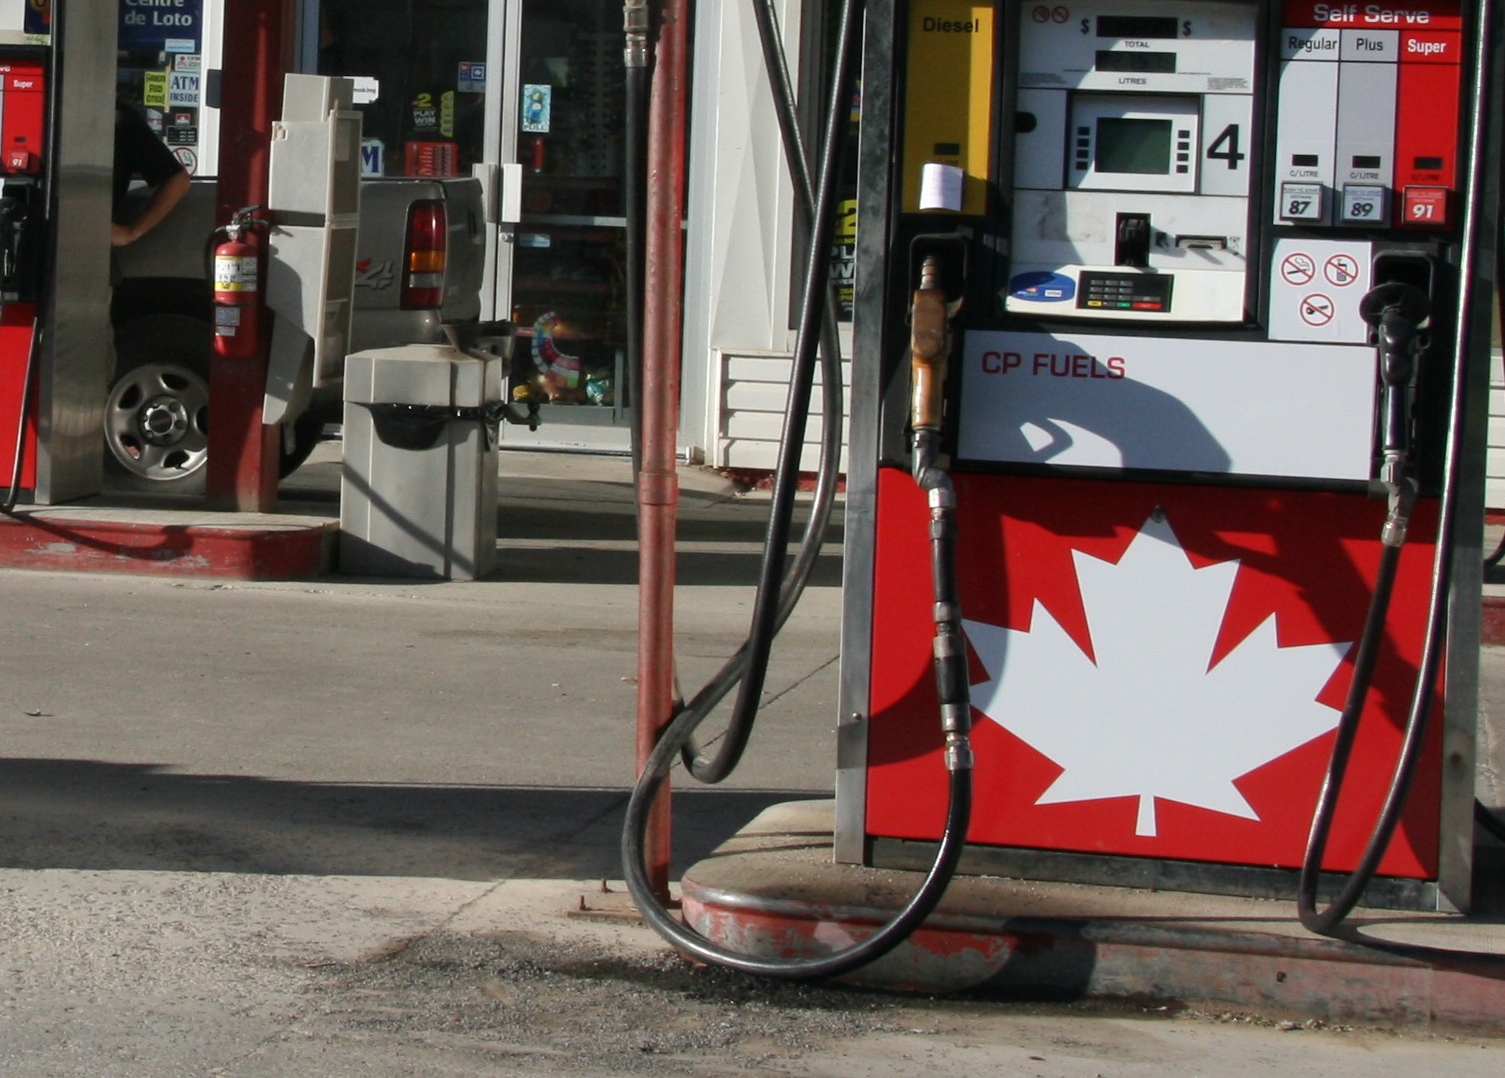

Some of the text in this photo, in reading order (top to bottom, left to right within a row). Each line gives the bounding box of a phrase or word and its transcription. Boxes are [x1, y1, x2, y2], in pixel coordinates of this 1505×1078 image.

[124, 9, 193, 26] de Loto
[1313, 3, 1430, 25] Self Serve
[922, 16, 980, 34] Diesel
[1124, 40, 1150, 49] TOTAL
[1288, 36, 1339, 53] Regular
[1356, 37, 1384, 52] Plus
[1407, 38, 1447, 56] Super
[13, 79, 34, 89] Super
[171, 76, 199, 91] ATM
[1118, 77, 1147, 86] LITRES
[169, 92, 199, 103] INSIDE
[413, 109, 436, 117] PLAY
[414, 116, 436, 124] WIN
[1206, 124, 1245, 171] 4
[1288, 200, 1312, 215] 87
[1350, 202, 1374, 217] 89
[1412, 204, 1434, 219] 91
[981, 351, 1127, 380] CP FUELS
